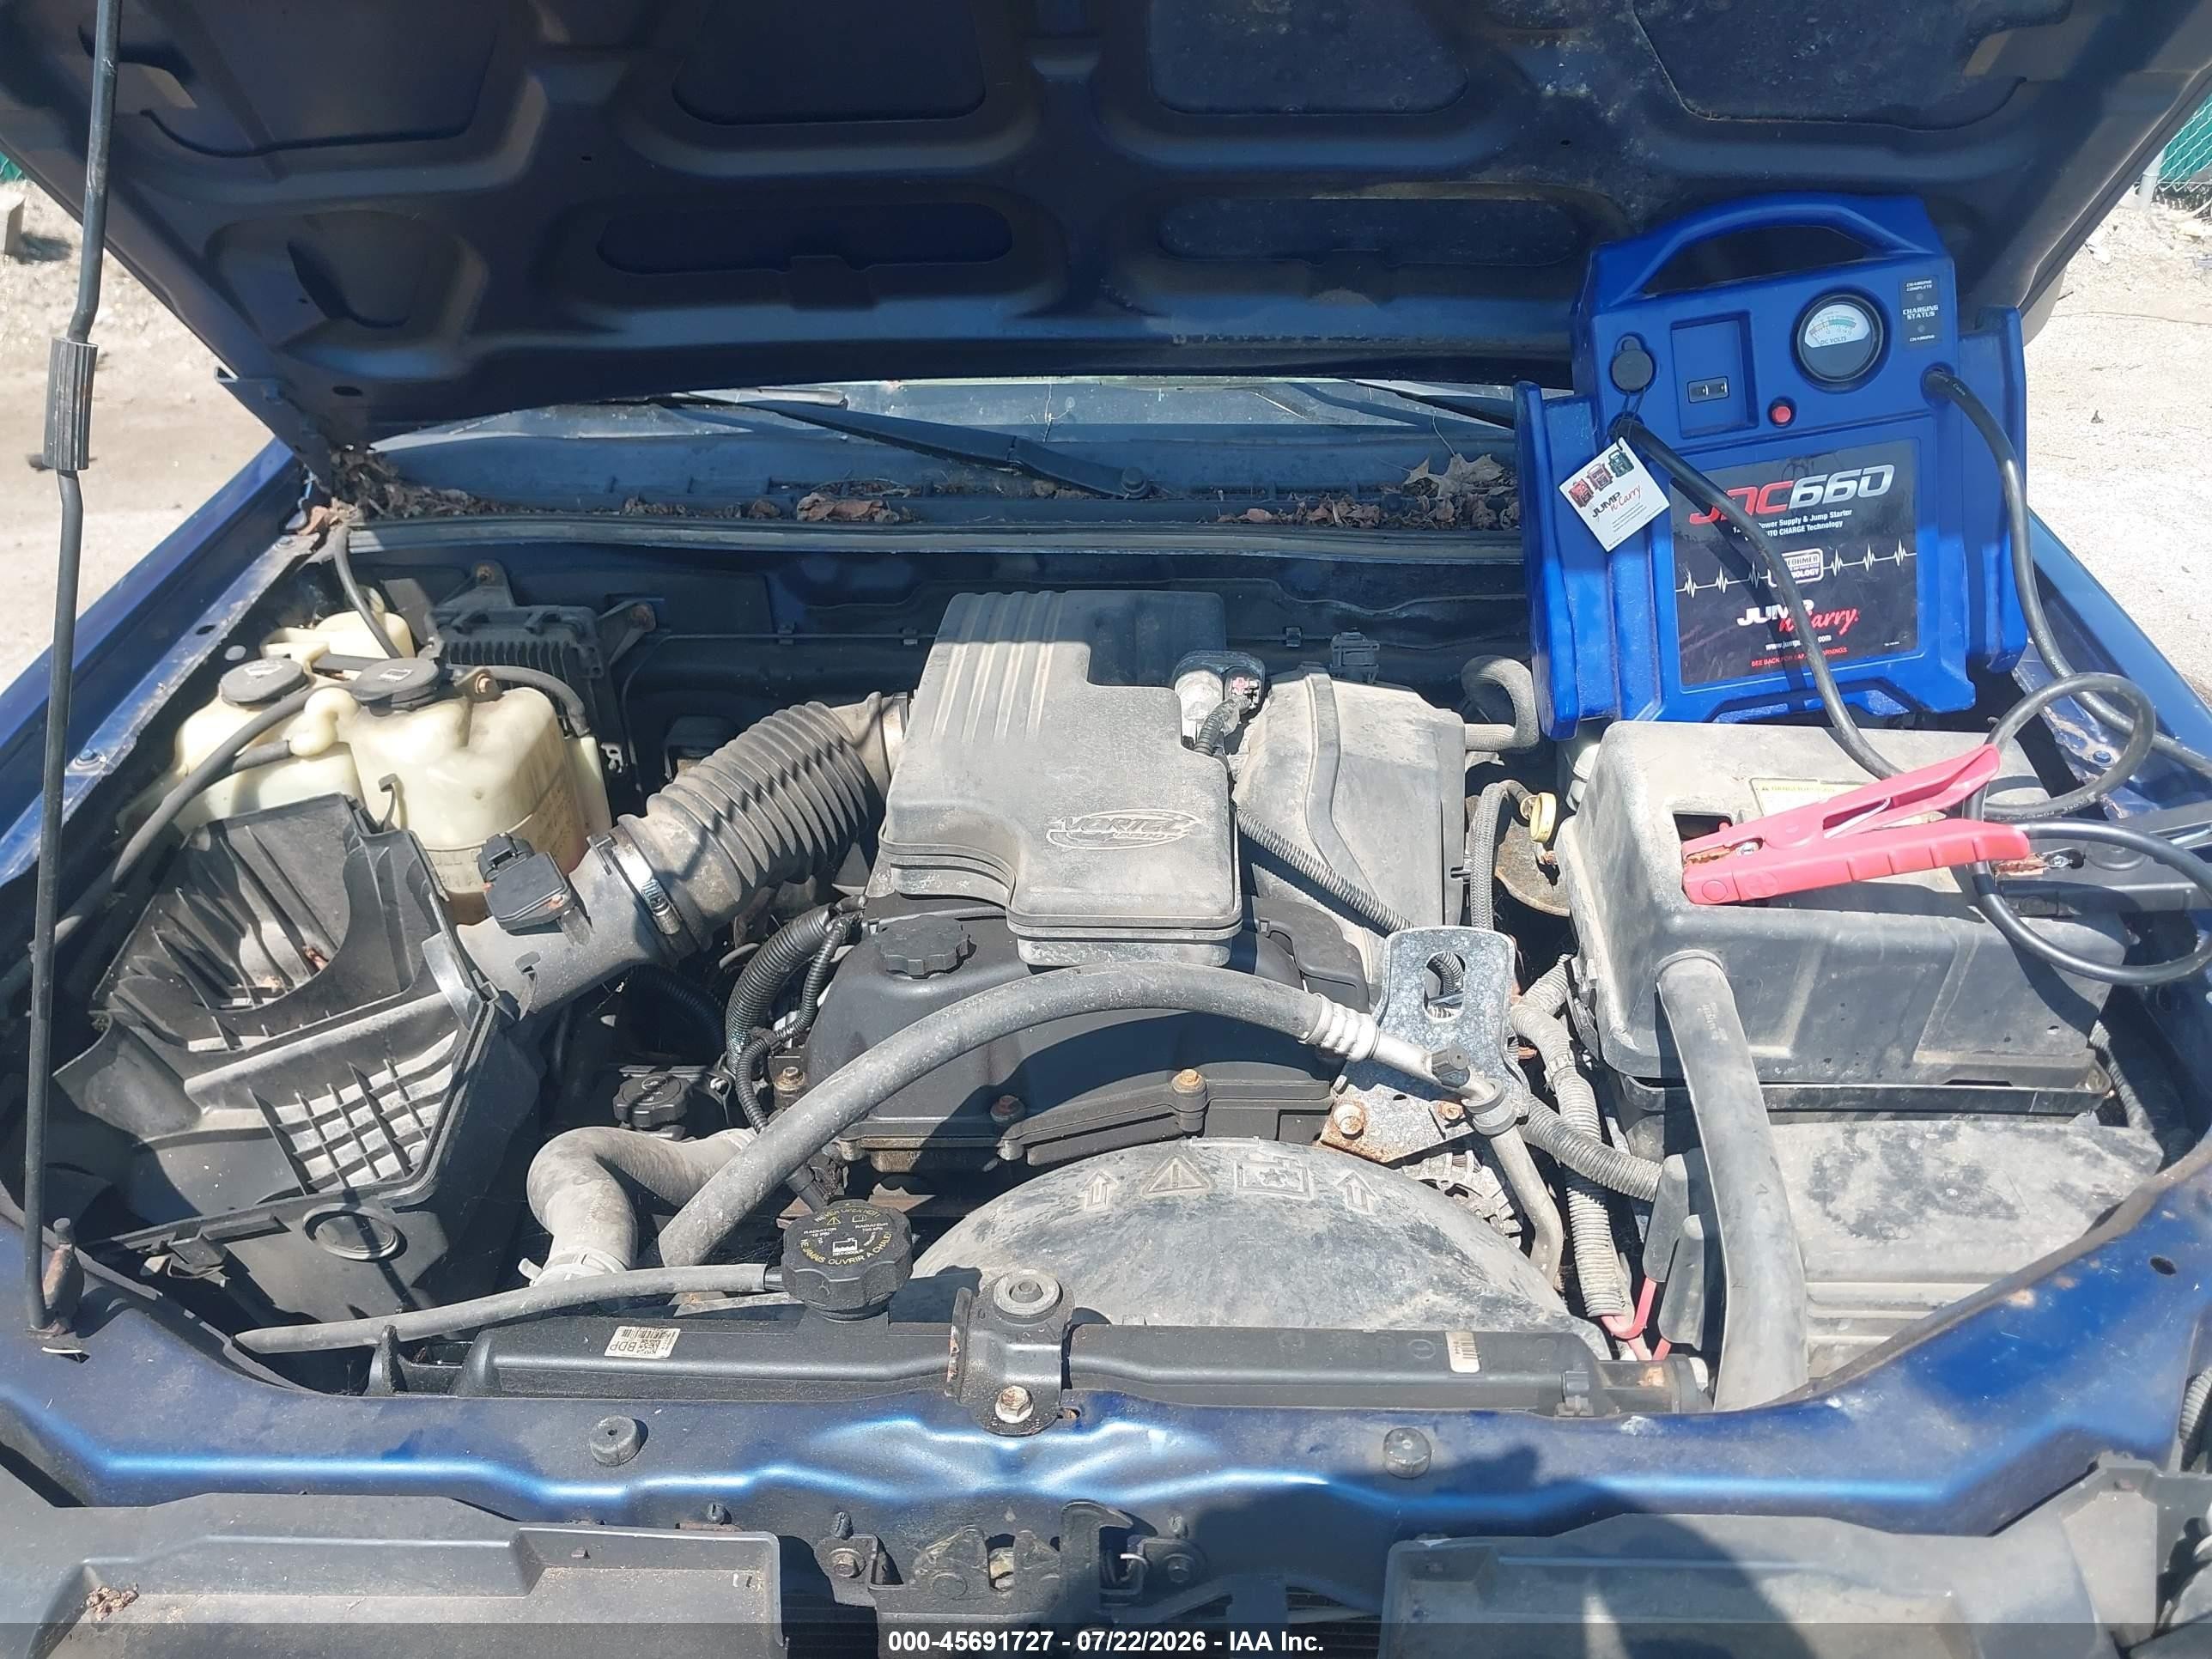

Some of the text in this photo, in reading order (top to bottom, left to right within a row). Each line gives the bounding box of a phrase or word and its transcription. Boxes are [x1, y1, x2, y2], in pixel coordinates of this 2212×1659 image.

[1902, 304, 1939, 315] CHARGING
[1906, 311, 1936, 320] STATUS
[1592, 491, 1620, 518] JUMP
[1758, 520, 1778, 530] ower
[1778, 518, 1802, 527] Supply
[1809, 513, 1828, 522] Jump
[1829, 509, 1853, 519] Starter
[1778, 525, 1806, 537] CHARGE
[1807, 520, 1844, 532] Technology
[1763, 657, 1780, 666] BACK
[1065, 817, 1191, 833] VORTEC
[813, 1208, 841, 1223] NEVER
[802, 1248, 826, 1263] JAMAIS
[828, 1255, 866, 1266] OUVRIR
[609, 1340, 637, 1352] BDP
